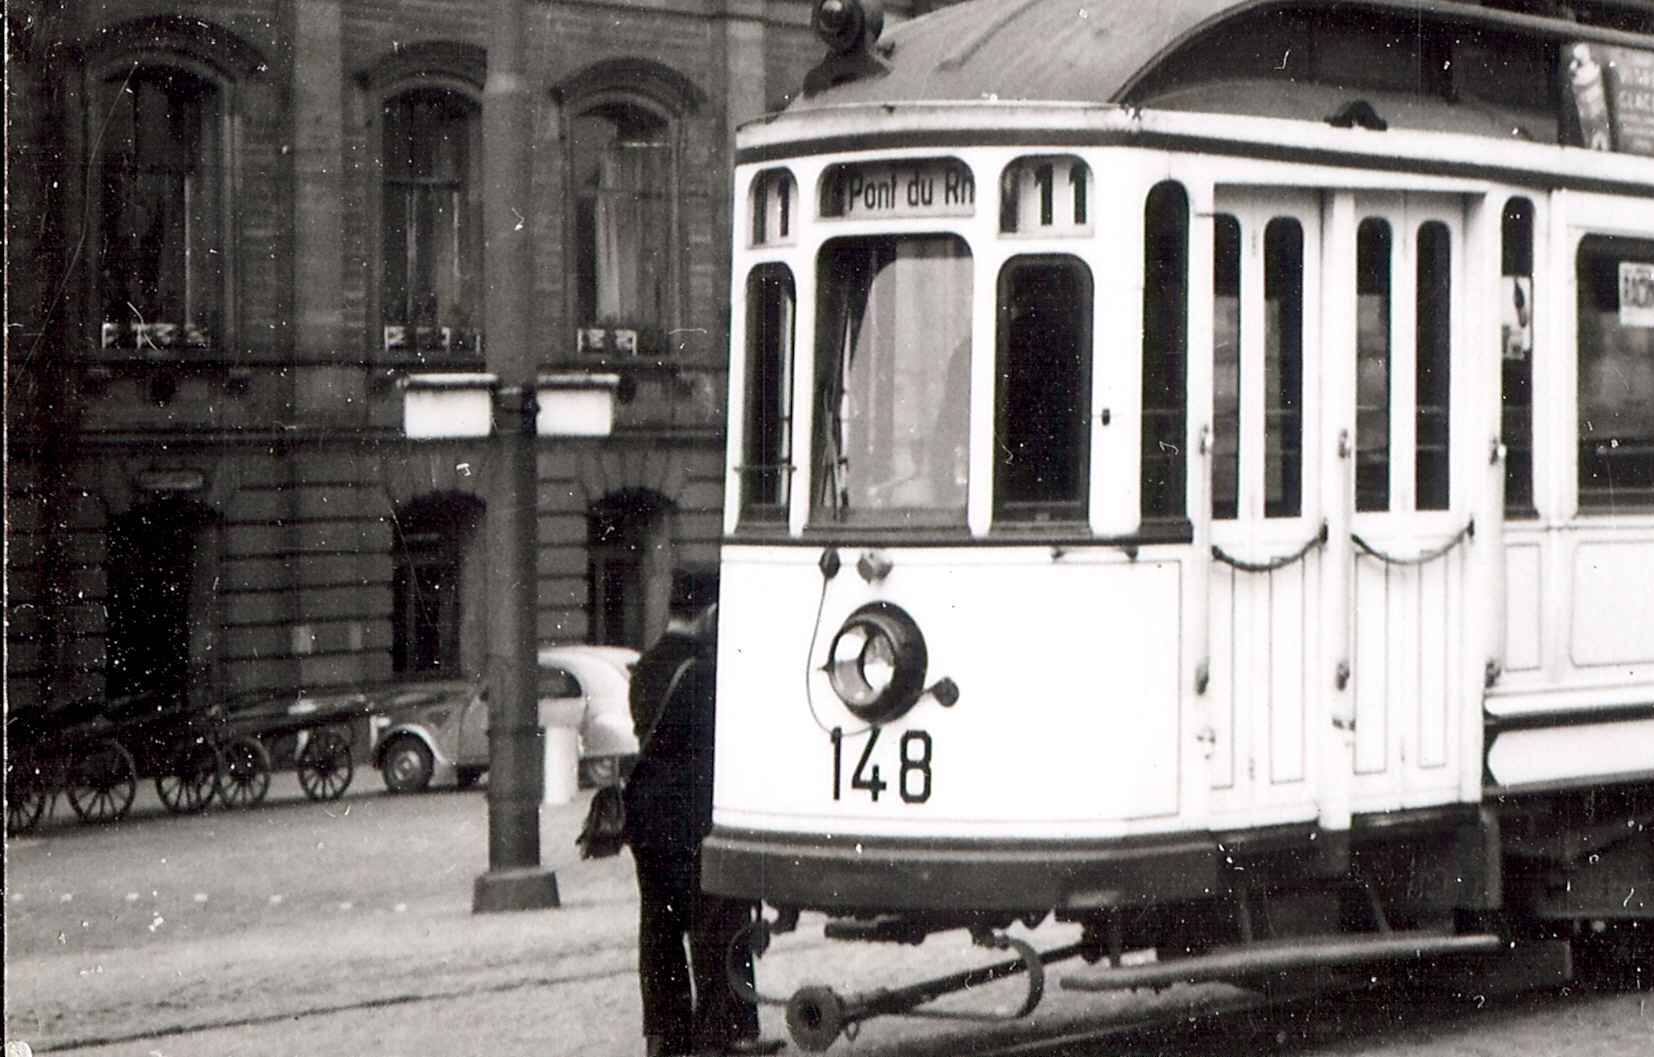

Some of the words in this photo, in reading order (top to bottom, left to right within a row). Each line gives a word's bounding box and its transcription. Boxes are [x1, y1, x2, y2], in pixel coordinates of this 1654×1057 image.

[849, 172, 898, 212] Pont
[907, 170, 933, 207] du
[1034, 161, 1087, 226] 11
[830, 724, 932, 804] 148
